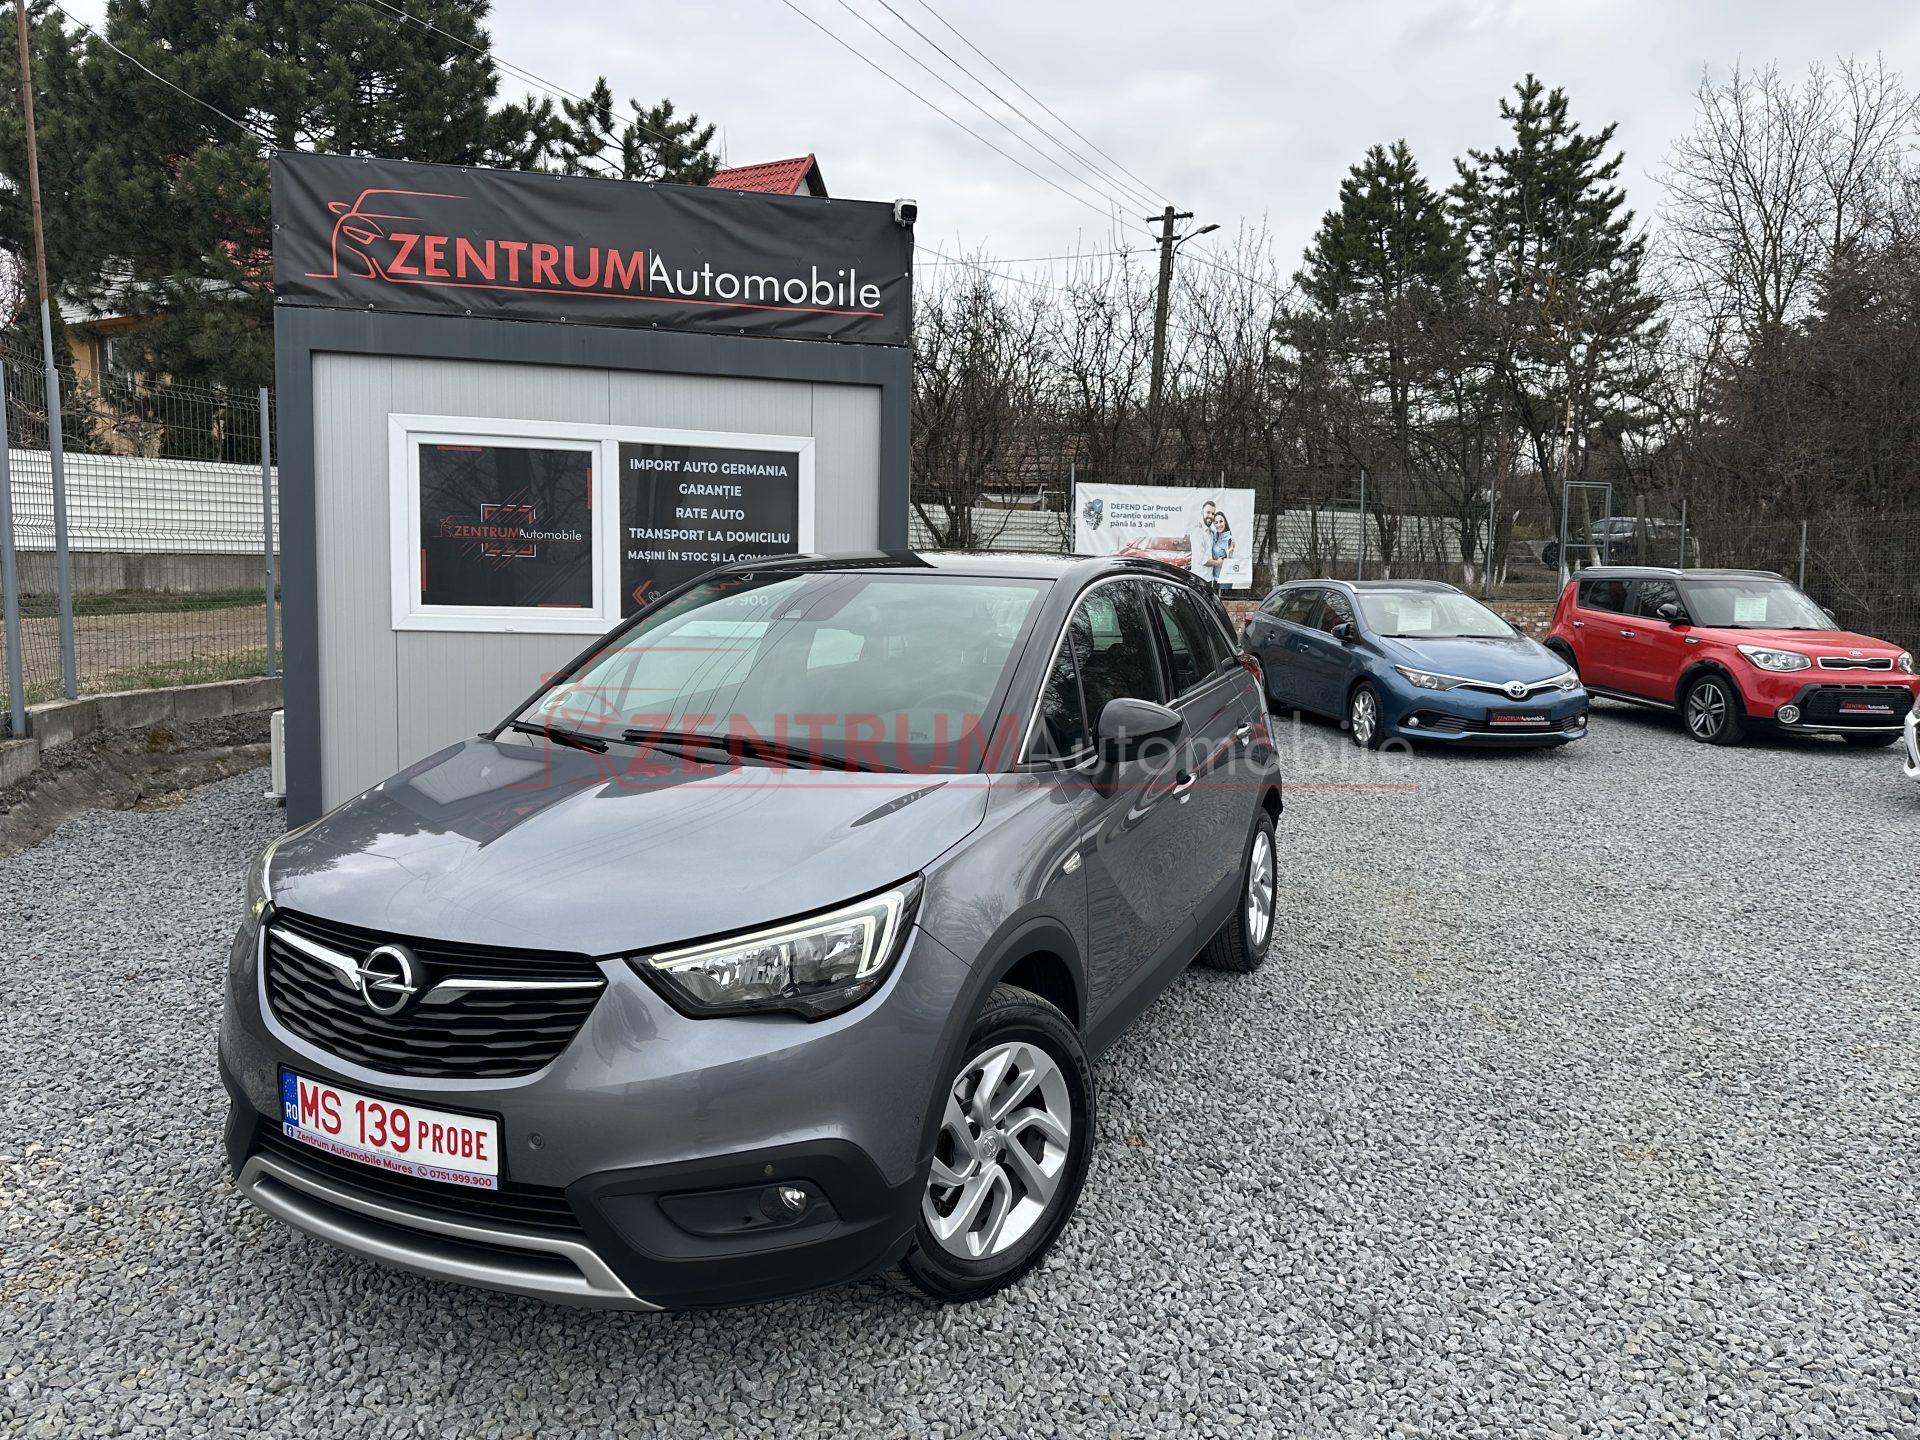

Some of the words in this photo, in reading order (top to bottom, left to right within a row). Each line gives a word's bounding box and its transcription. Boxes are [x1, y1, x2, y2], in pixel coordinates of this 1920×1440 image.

[630, 458, 681, 472] IMPORT
[683, 461, 718, 474] AUTO
[721, 463, 788, 477] GERMANIA
[679, 483, 742, 500] GARANȚIE
[676, 507, 707, 519] RATE
[711, 509, 745, 520] AUTO
[1110, 503, 1140, 511] DEFEND
[629, 528, 704, 541] TRANSPORT
[708, 531, 723, 542] LA
[727, 532, 790, 544] DOMICILIU
[628, 550, 665, 563] MAȘINI
[668, 549, 678, 560] ÎN
[681, 552, 708, 561] STOC
[711, 553, 720, 564] ȘI
[722, 553, 735, 562] LA
[286, 1102, 298, 1121] RO
[299, 1081, 342, 1135] MS
[355, 1100, 411, 1153] 139
[418, 1120, 488, 1161] PROBE
[296, 1130, 330, 1149] Zentrum
[331, 1145, 382, 1165] Automobile
[383, 1159, 413, 1173] Mures
[429, 1170, 492, 1186] 0751.999.900
